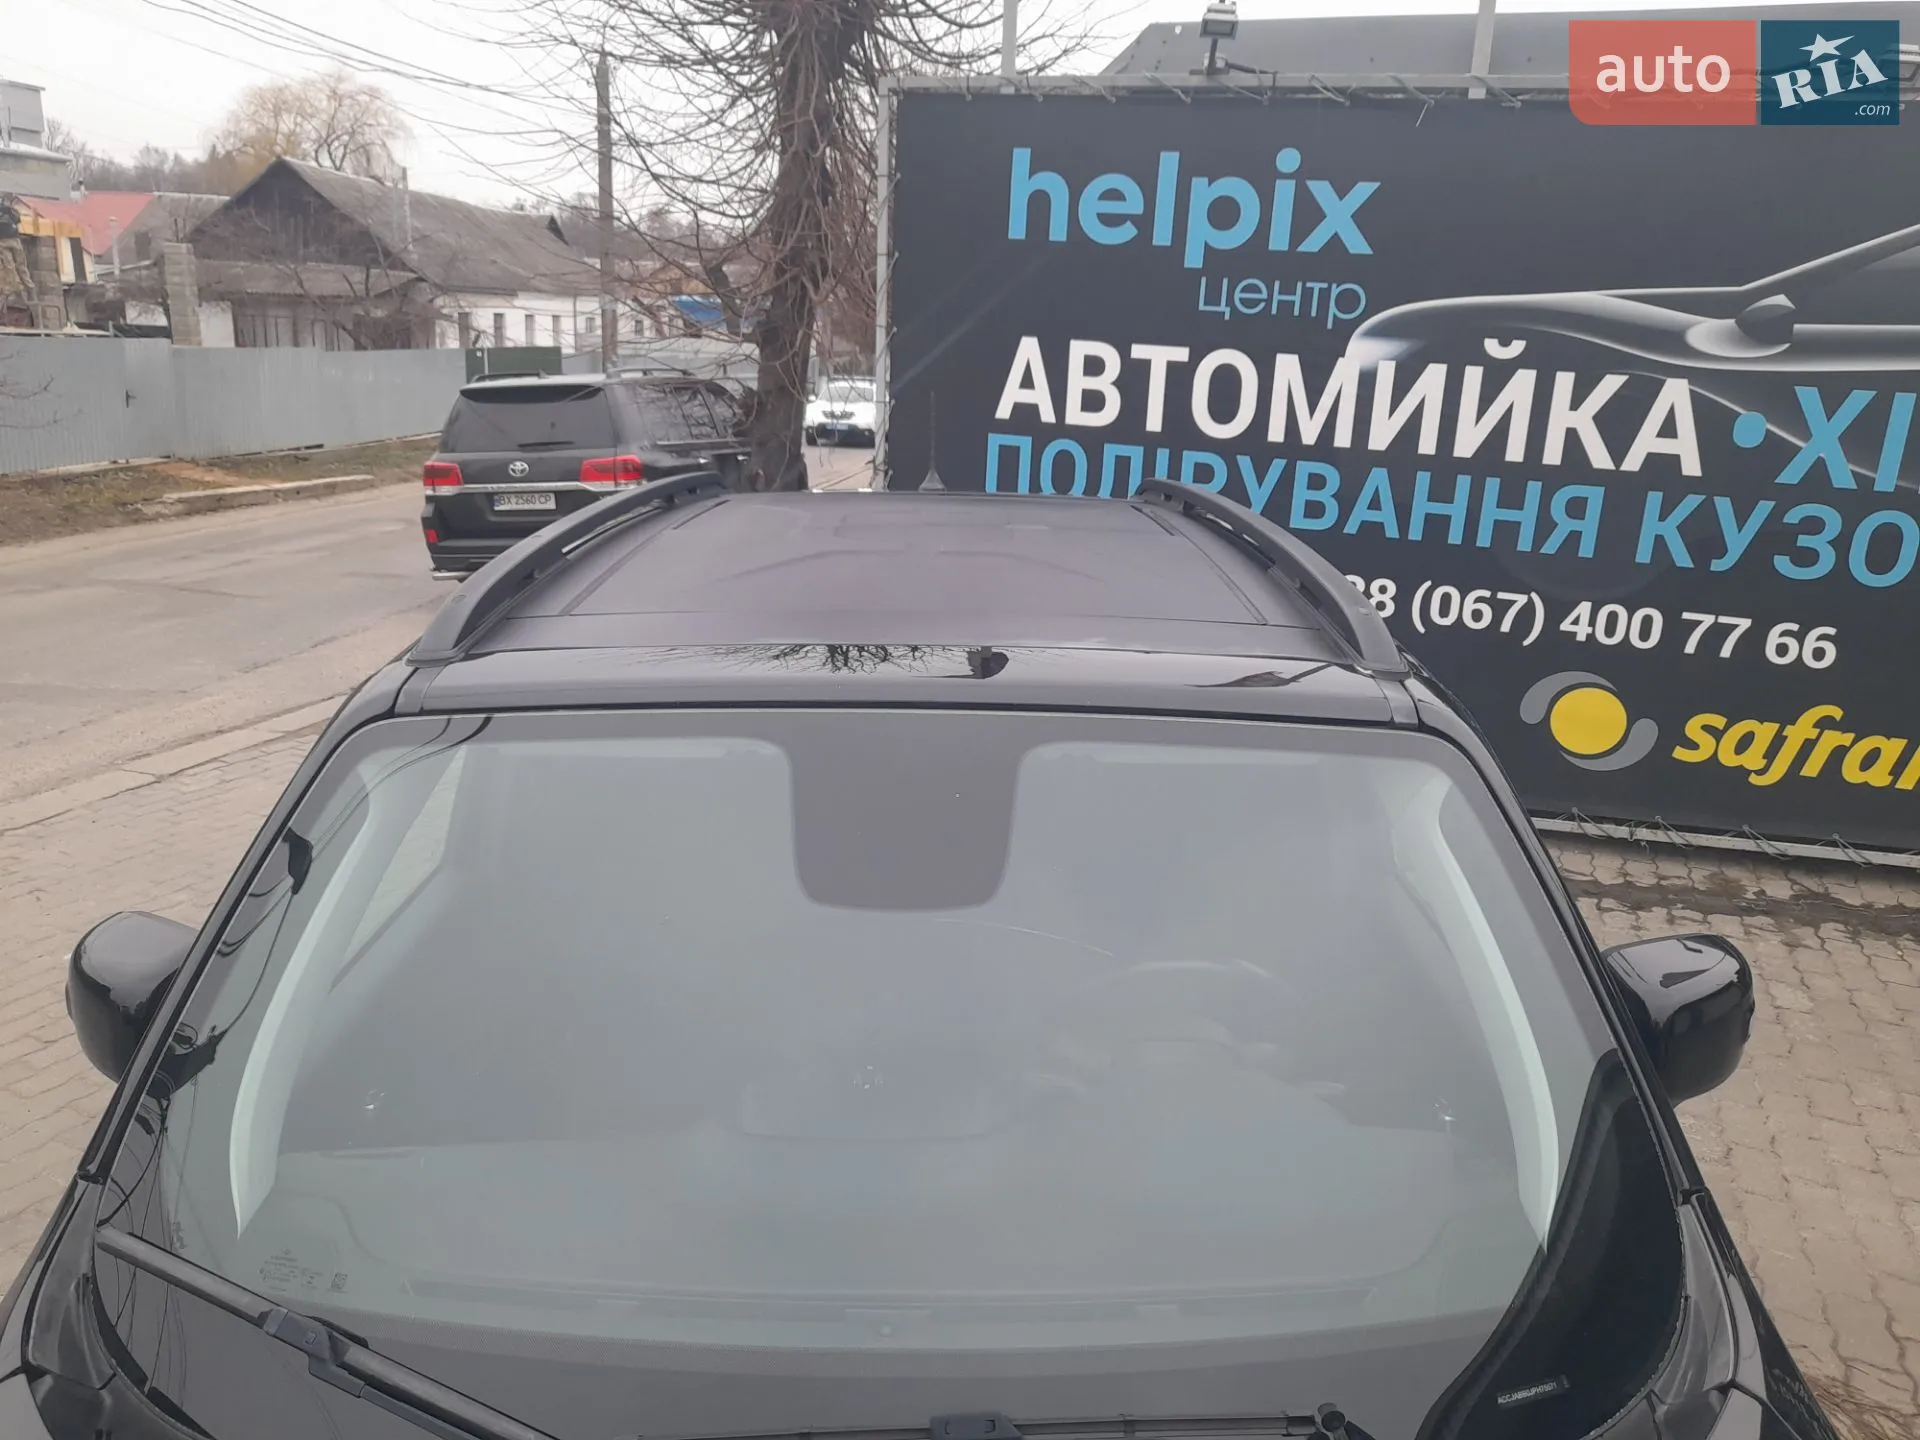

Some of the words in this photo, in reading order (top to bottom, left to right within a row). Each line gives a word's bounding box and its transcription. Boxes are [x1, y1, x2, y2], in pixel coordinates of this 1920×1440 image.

[1008, 147, 1381, 269] helpix
[1198, 276, 1367, 330] центр
[994, 335, 1703, 477] АВТОМИЙКА
[515, 494, 537, 505] 2560
[1635, 491, 1920, 588] КУЗО
[1411, 579, 1545, 647] (067)
[1559, 601, 1663, 649] 400
[1681, 612, 1752, 659] 77
[1765, 622, 1837, 669] 66
